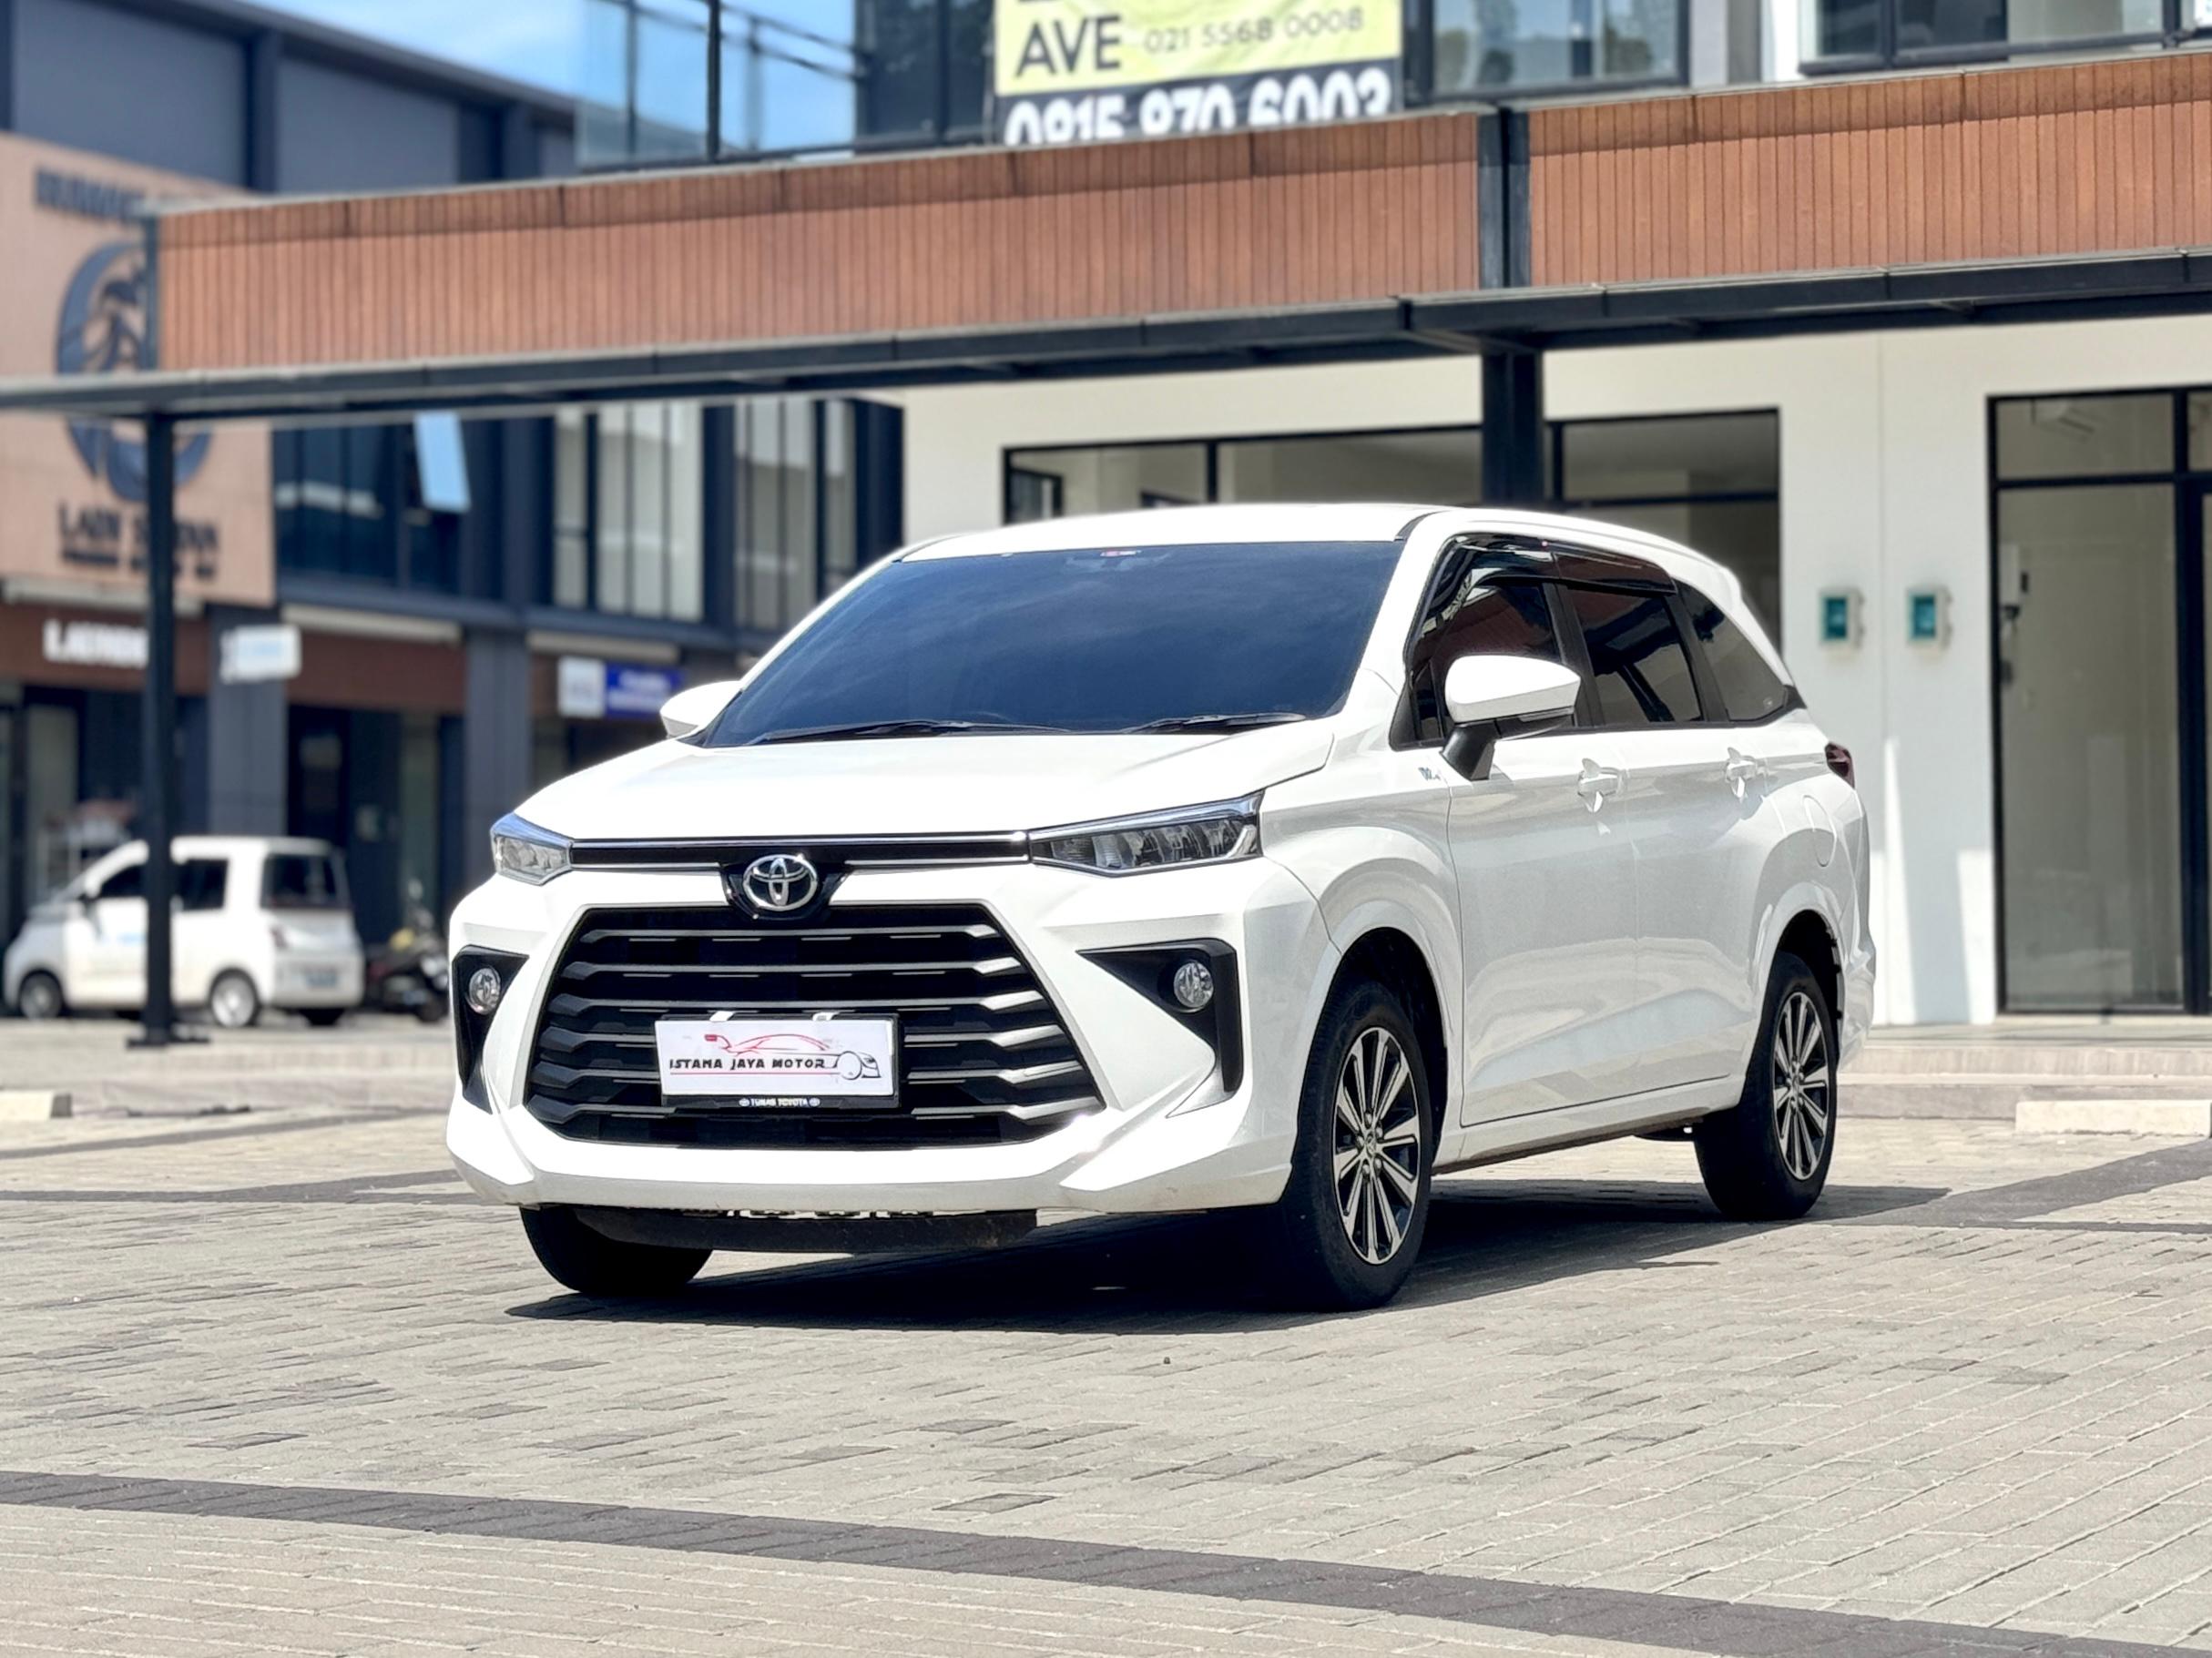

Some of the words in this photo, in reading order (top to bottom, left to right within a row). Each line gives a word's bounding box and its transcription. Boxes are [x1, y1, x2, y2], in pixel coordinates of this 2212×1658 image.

[1014, 15, 1121, 77] AVE
[1145, 27, 1189, 54] 021
[1201, 16, 1272, 46] 5568
[1285, 6, 1362, 38] 0008
[669, 1058, 723, 1069] ISTANA
[730, 1058, 765, 1071] JAYA
[771, 1058, 825, 1069] MOTOR
